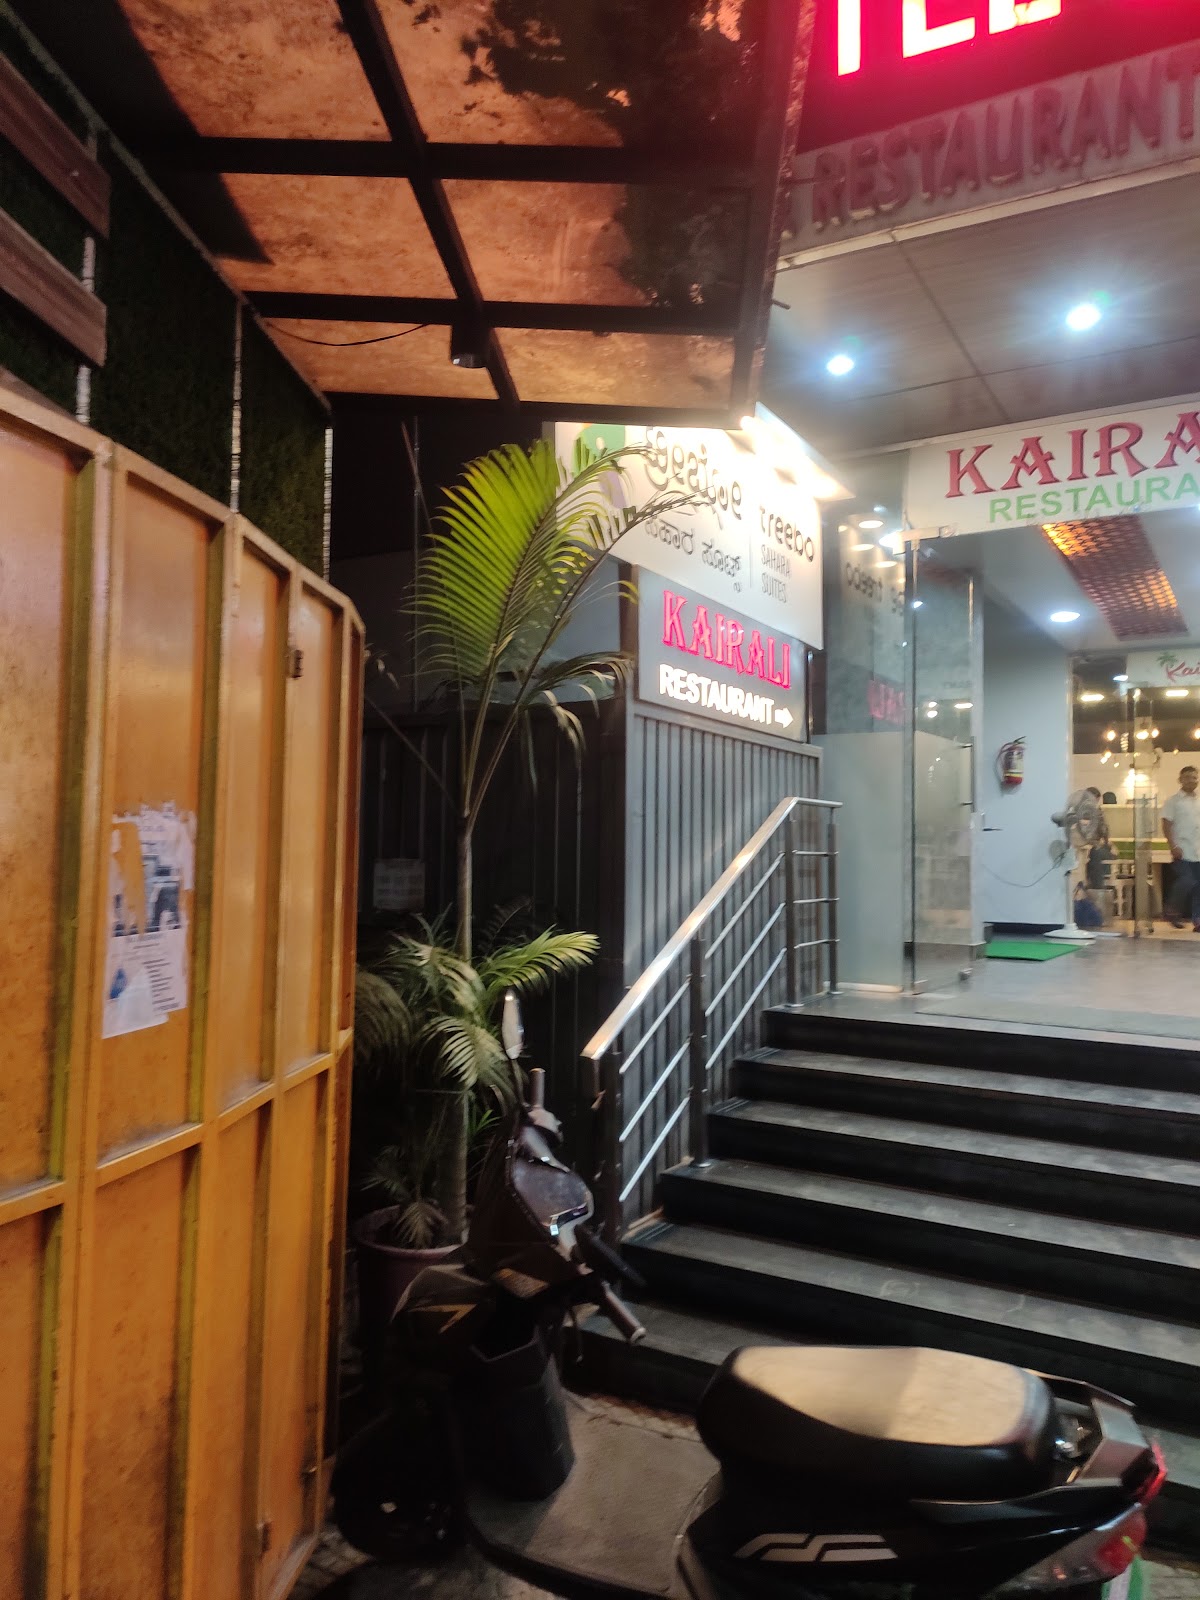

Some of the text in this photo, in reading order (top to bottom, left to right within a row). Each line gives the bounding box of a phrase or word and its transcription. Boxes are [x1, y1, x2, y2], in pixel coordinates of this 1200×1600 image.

[811, 50, 1200, 232] RESTAURANT
[945, 411, 1200, 498] KAIRA
[759, 505, 815, 563] treebo
[761, 544, 791, 579] SAHARA
[762, 571, 787, 603] SUITES
[661, 589, 792, 690] KAIRALI
[658, 663, 775, 725] RESTAURANT
